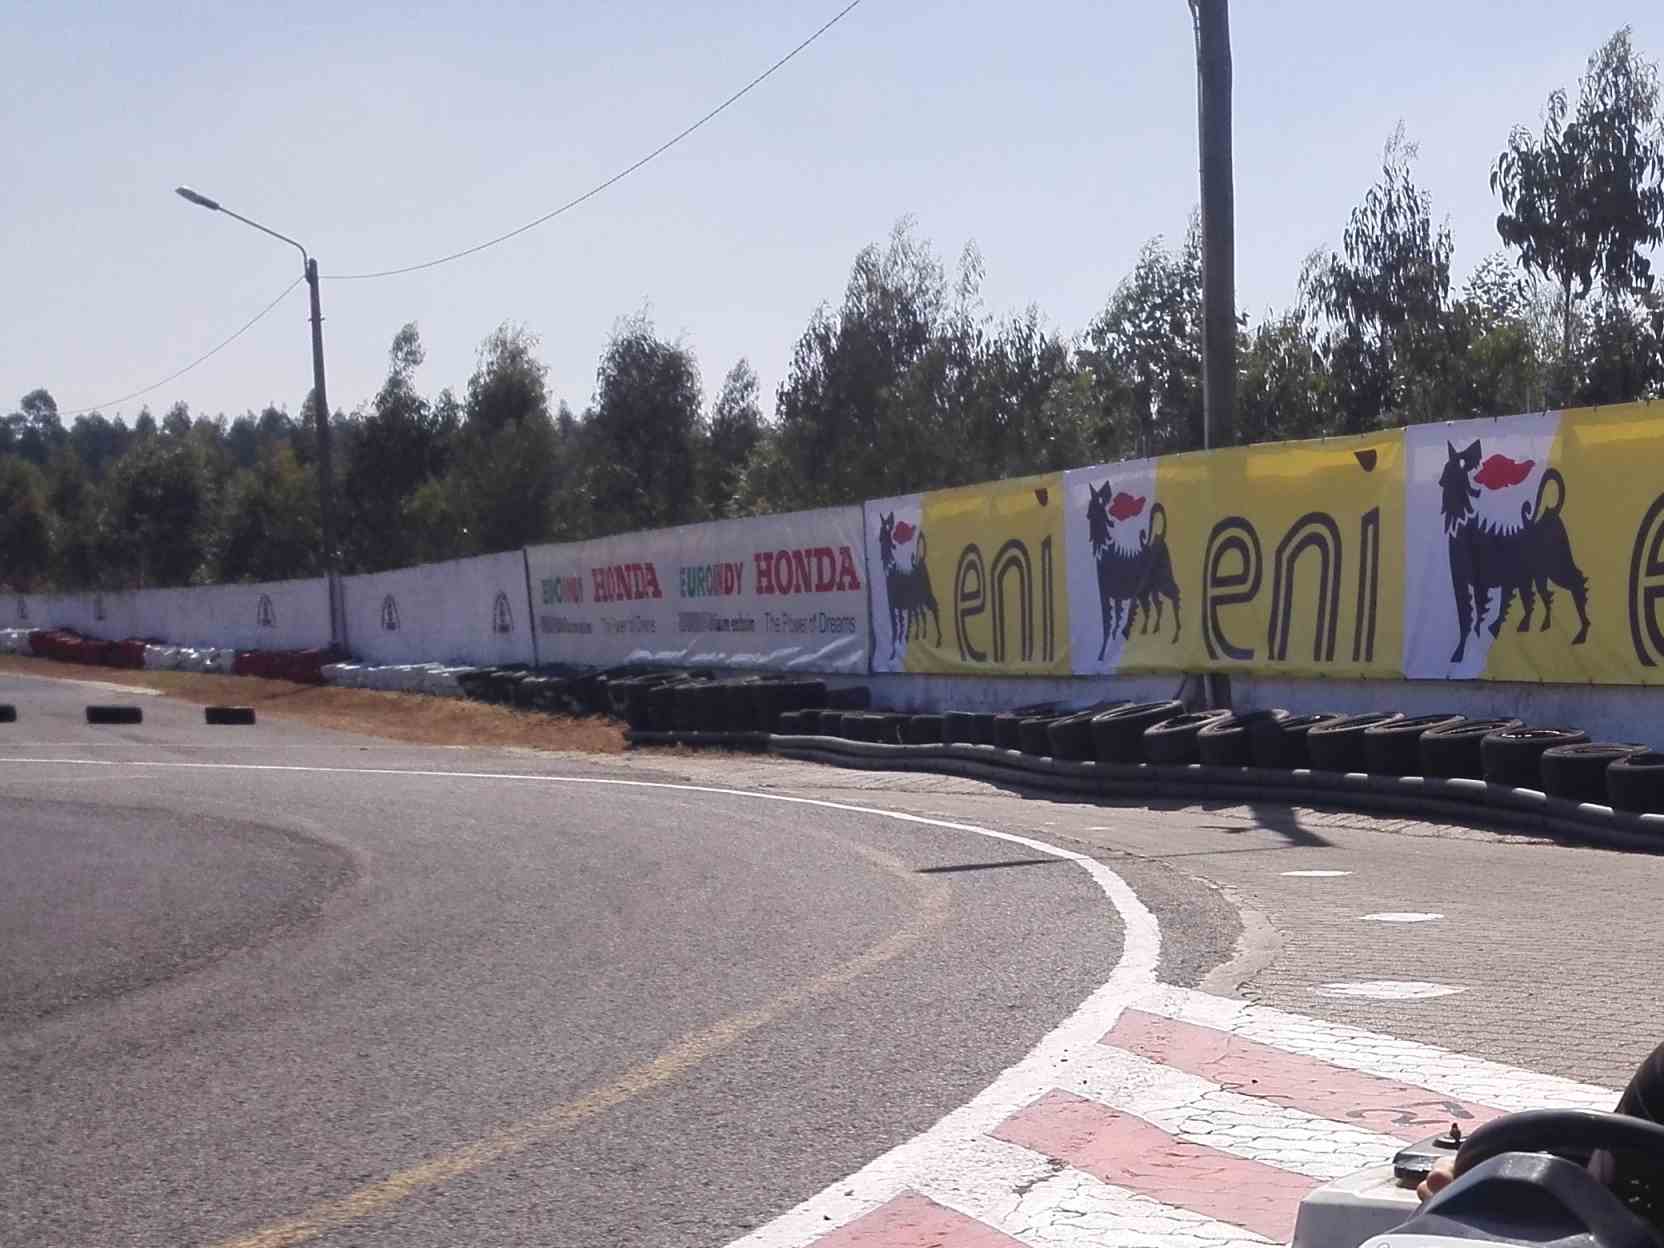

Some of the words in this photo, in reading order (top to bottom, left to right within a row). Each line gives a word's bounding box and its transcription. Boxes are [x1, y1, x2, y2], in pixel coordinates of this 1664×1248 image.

[754, 546, 861, 595] HONDA
[954, 487, 1055, 662] eni
[1201, 448, 1384, 662] eni
